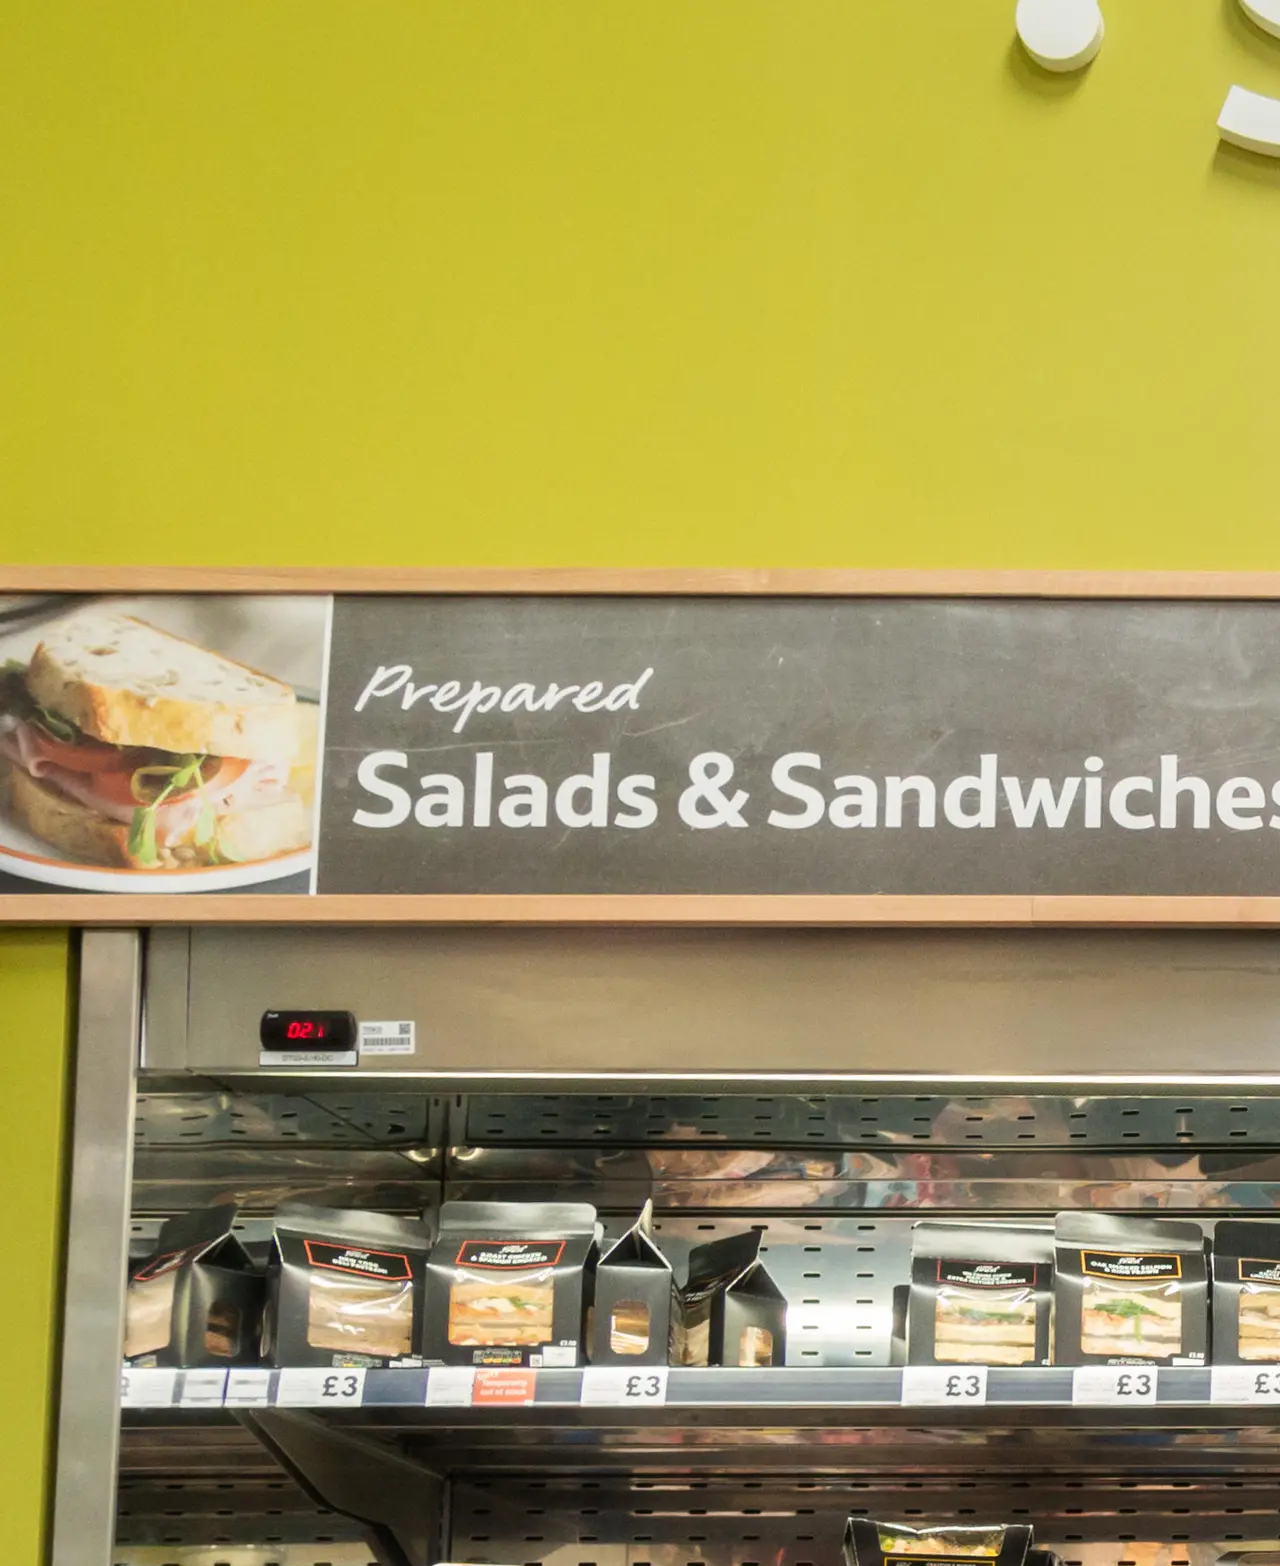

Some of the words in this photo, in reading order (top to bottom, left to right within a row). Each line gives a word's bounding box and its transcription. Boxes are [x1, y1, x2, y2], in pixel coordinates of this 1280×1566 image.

[354, 664, 654, 732] Prepared
[353, 751, 659, 832] Salads
[677, 755, 750, 831] &
[321, 1375, 358, 1397] £3
[626, 1375, 661, 1397] £3
[946, 1375, 981, 1397] £3
[1116, 1375, 1152, 1397] £3
